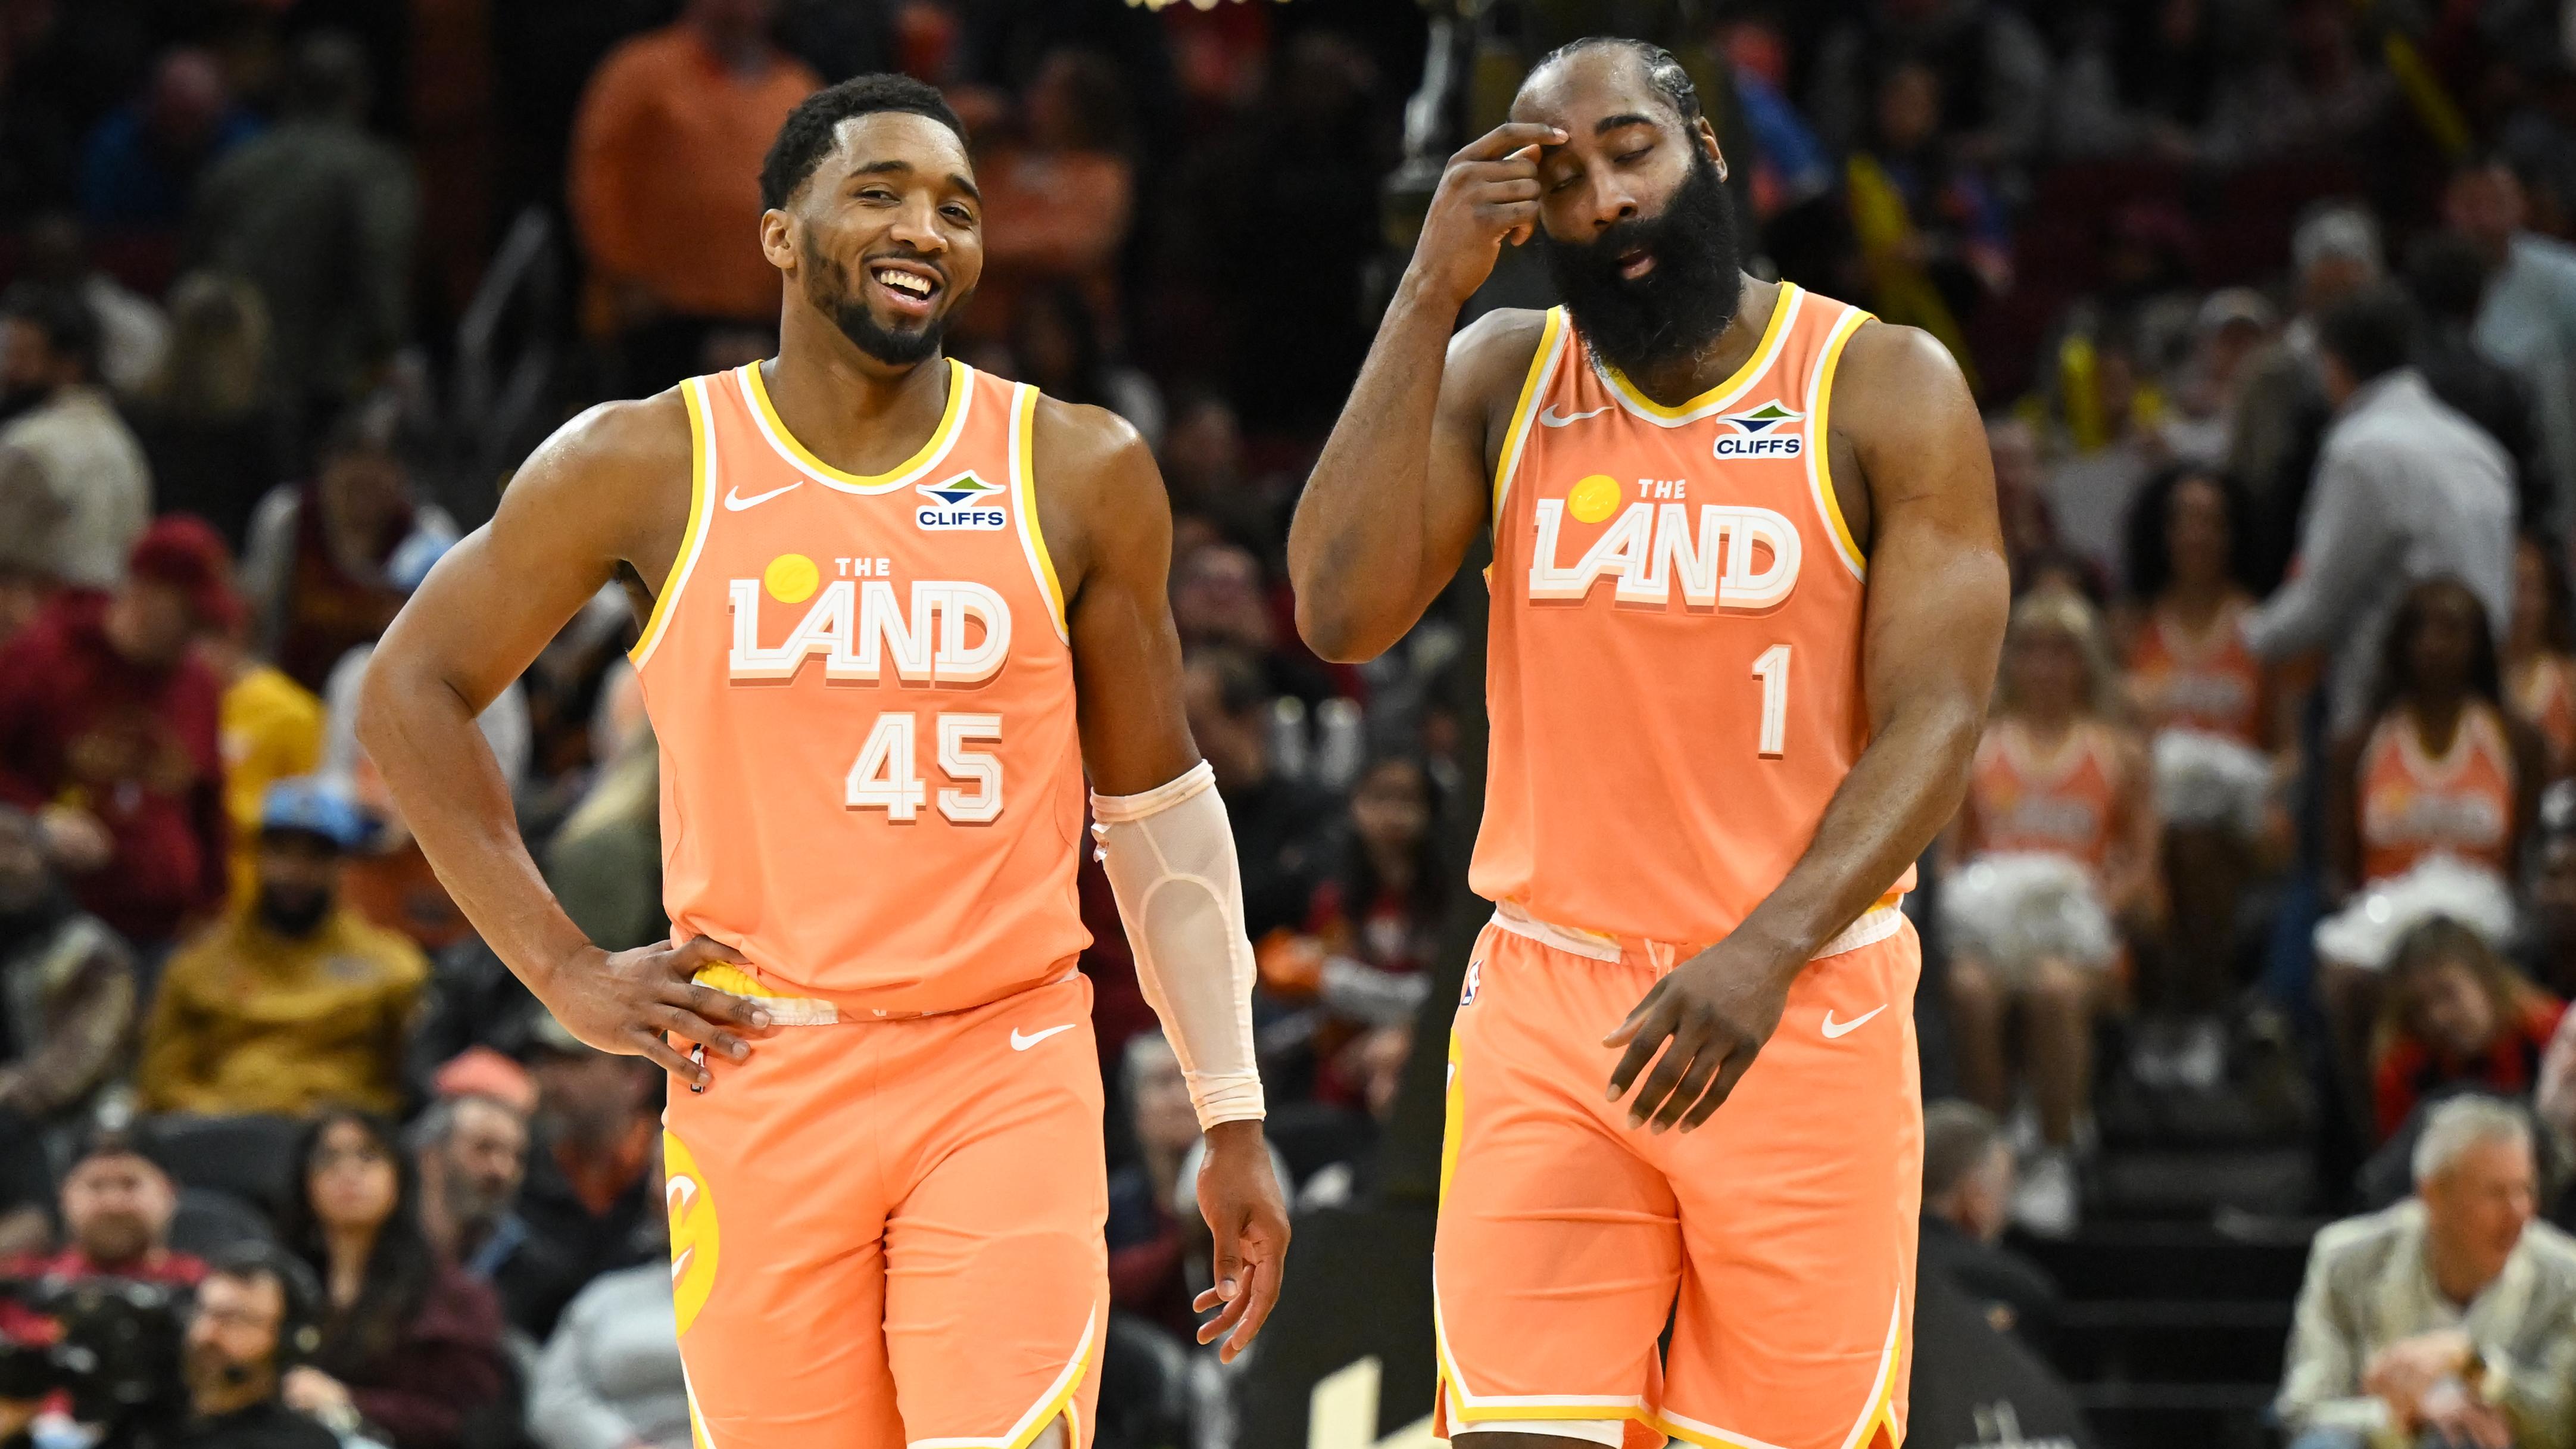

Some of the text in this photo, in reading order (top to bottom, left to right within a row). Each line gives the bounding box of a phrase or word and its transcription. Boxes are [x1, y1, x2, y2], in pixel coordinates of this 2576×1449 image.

[1716, 438, 1800, 454] CLIFFS
[918, 510, 1004, 526] CLIFFS
[1638, 478, 1686, 499] THE
[834, 557, 891, 577] THE
[1529, 498, 1802, 615] LAND
[728, 579, 1012, 689] LAND
[1752, 644, 1792, 759] 1
[845, 711, 1005, 827] 45
